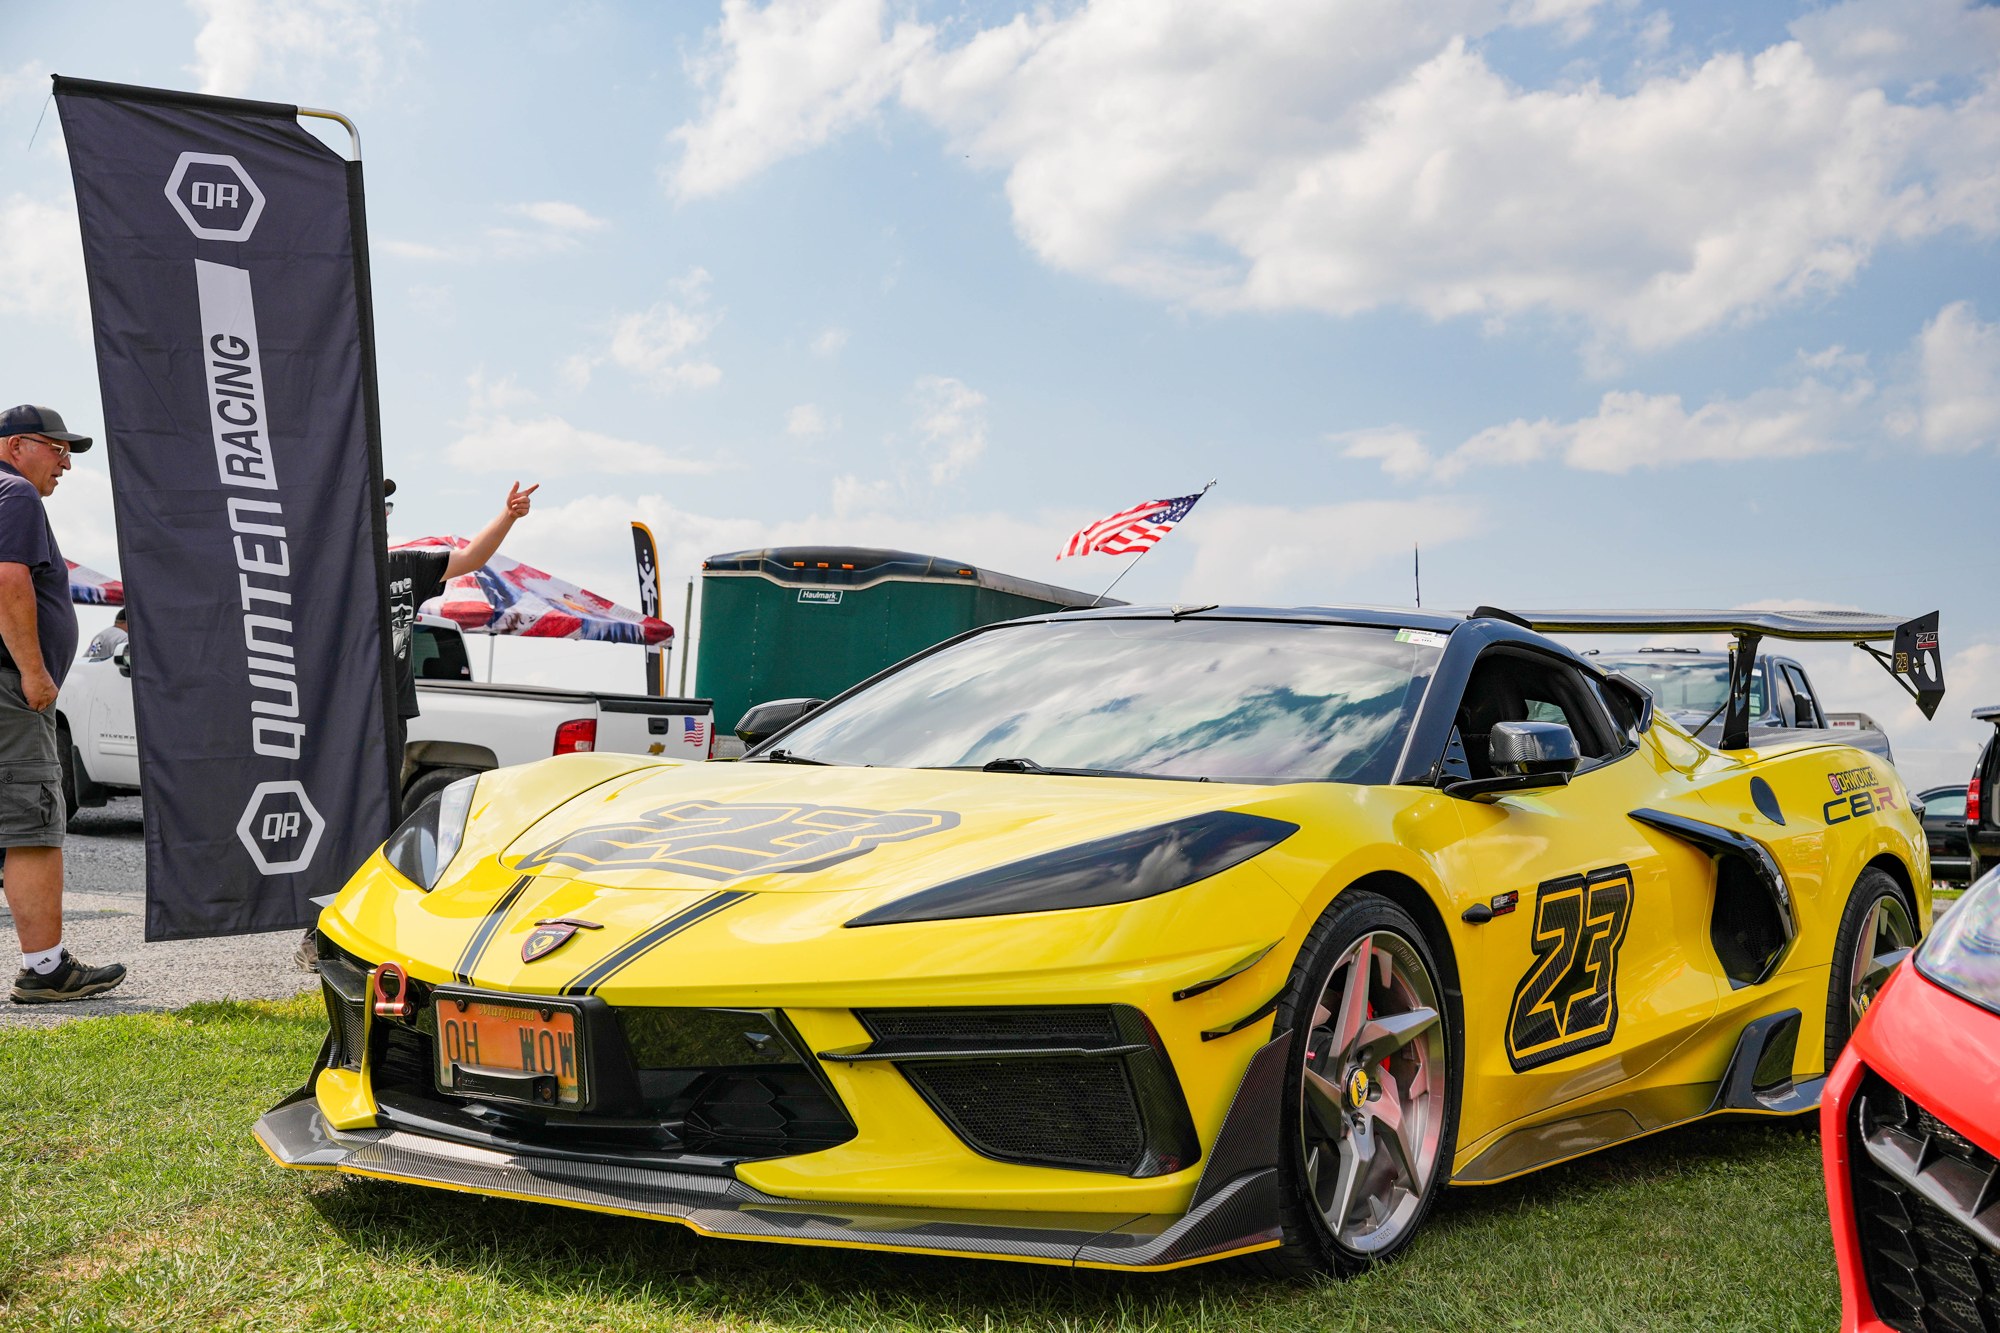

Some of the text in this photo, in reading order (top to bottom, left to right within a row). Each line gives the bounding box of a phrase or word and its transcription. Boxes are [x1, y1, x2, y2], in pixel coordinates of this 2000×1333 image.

[191, 181, 239, 209] QR
[210, 333, 306, 760] QUINTEN RACING
[1823, 786, 1898, 825] C8.R
[261, 812, 300, 842] QR
[1505, 863, 1635, 1074] 23
[479, 1003, 535, 1022] Maryland
[445, 1018, 575, 1079] OH WOW
